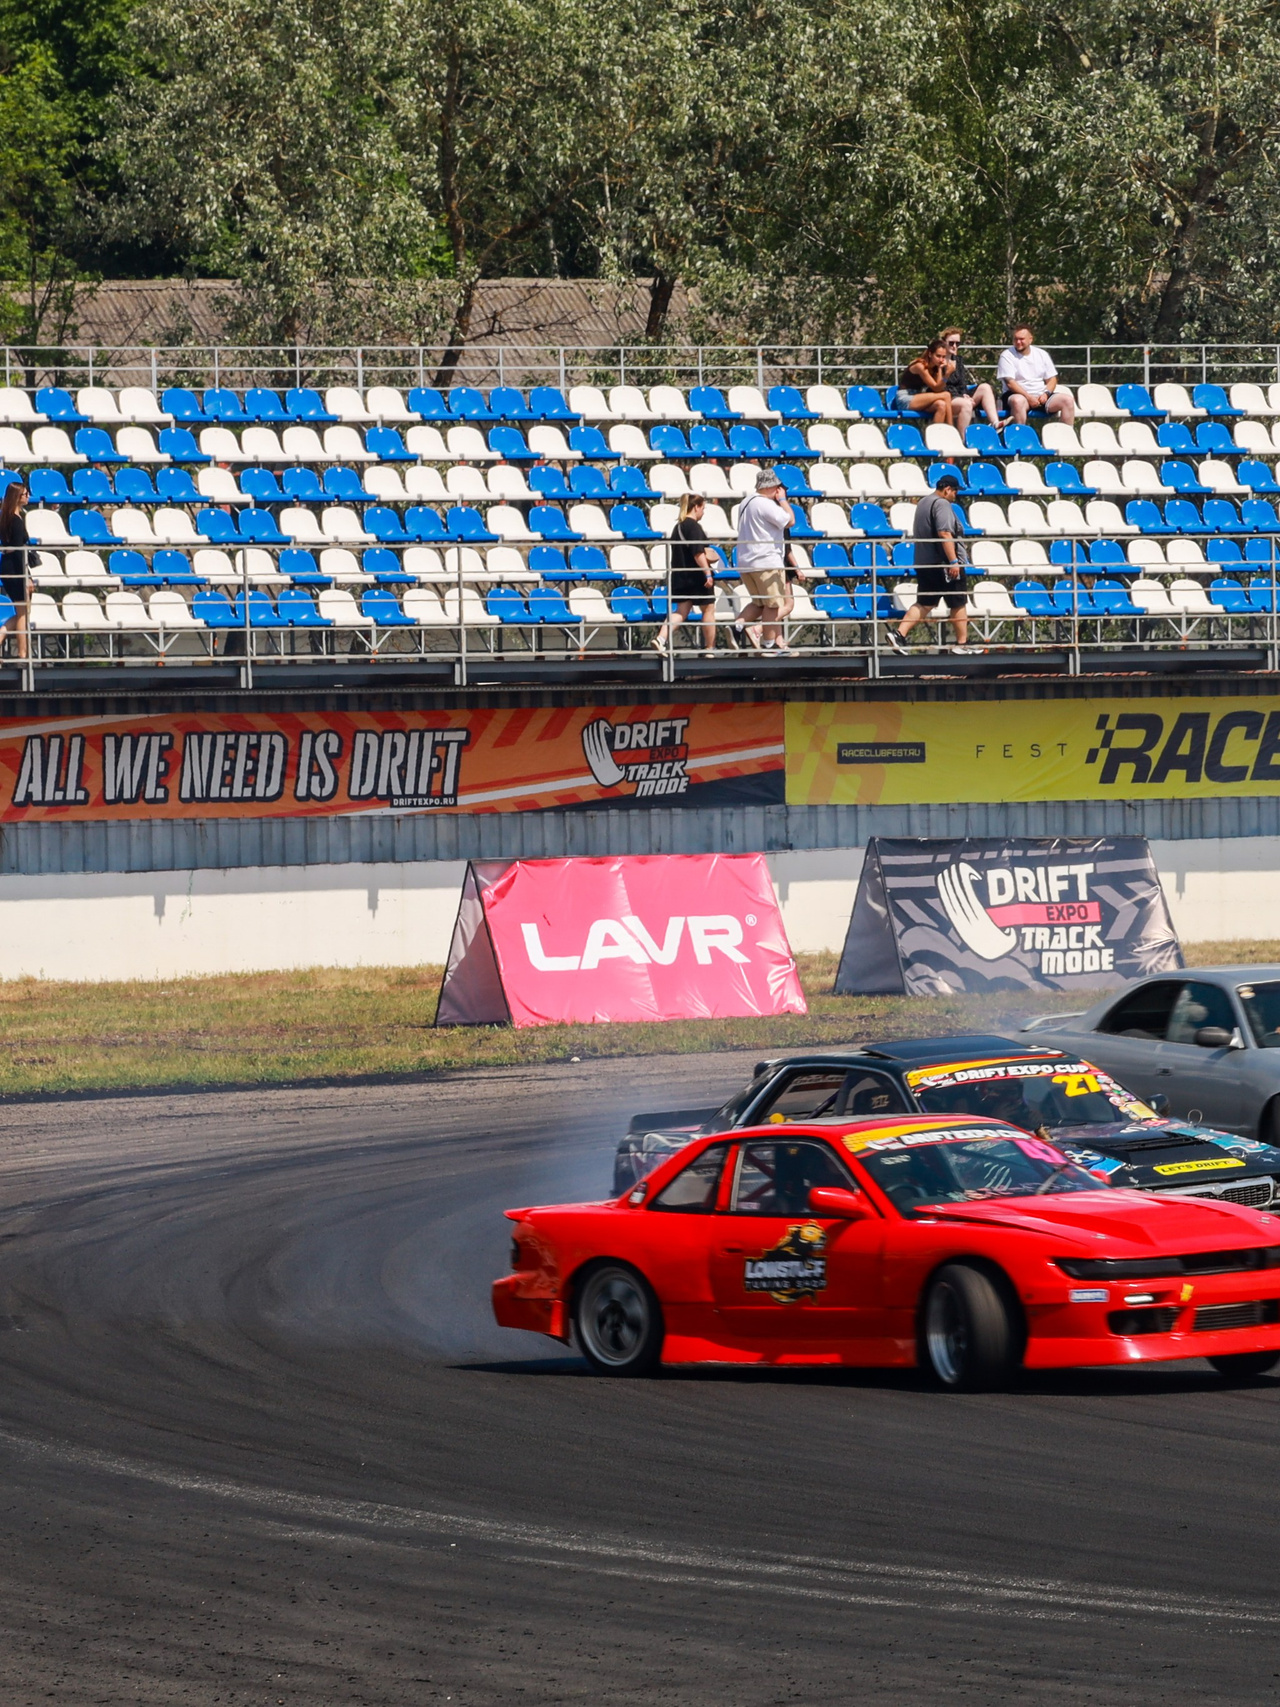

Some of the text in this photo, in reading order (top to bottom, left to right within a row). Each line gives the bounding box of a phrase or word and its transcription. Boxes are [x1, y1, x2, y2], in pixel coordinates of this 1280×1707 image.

[614, 719, 689, 750] DRIFT
[650, 747, 679, 760] EXPO
[975, 742, 1068, 759] FEST
[13, 730, 467, 803] ALL WE NEED IS DRIFT
[627, 761, 685, 782] TRACK
[636, 777, 690, 798] MODE
[393, 797, 455, 806] DRIFTEXPO.RU
[986, 863, 1095, 906] DRIFT
[1046, 904, 1089, 921] EXPO
[1021, 925, 1105, 951] TRACK
[1041, 948, 1114, 975] MODE
[954, 1067, 1007, 1083] DRIFT
[1007, 1063, 1051, 1077] EXPO
[1053, 1063, 1090, 1074] CUP
